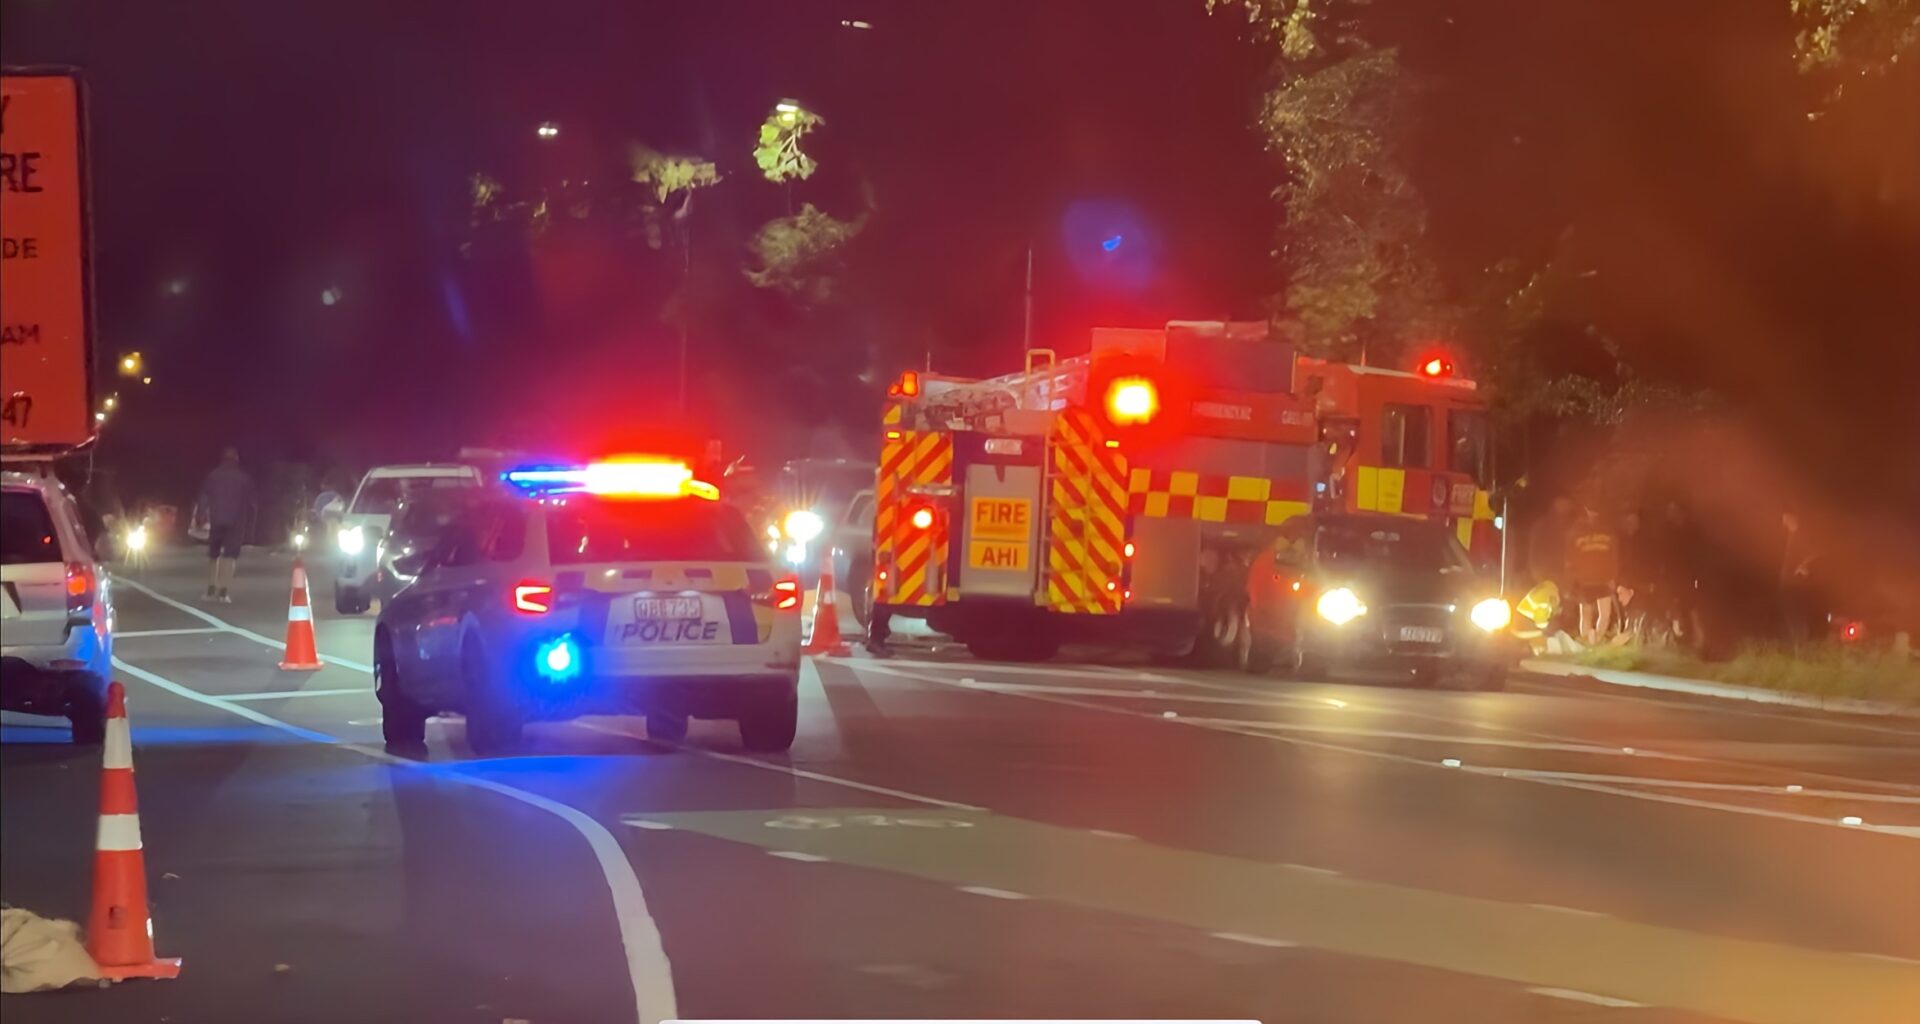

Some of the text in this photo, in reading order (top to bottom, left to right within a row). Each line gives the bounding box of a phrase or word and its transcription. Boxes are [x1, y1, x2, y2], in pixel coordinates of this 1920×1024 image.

[2, 238, 37, 258] DE
[2, 396, 32, 428] 47
[976, 502, 1027, 525] FIRE
[981, 547, 1019, 567] AHI
[621, 620, 719, 641] POLICE
